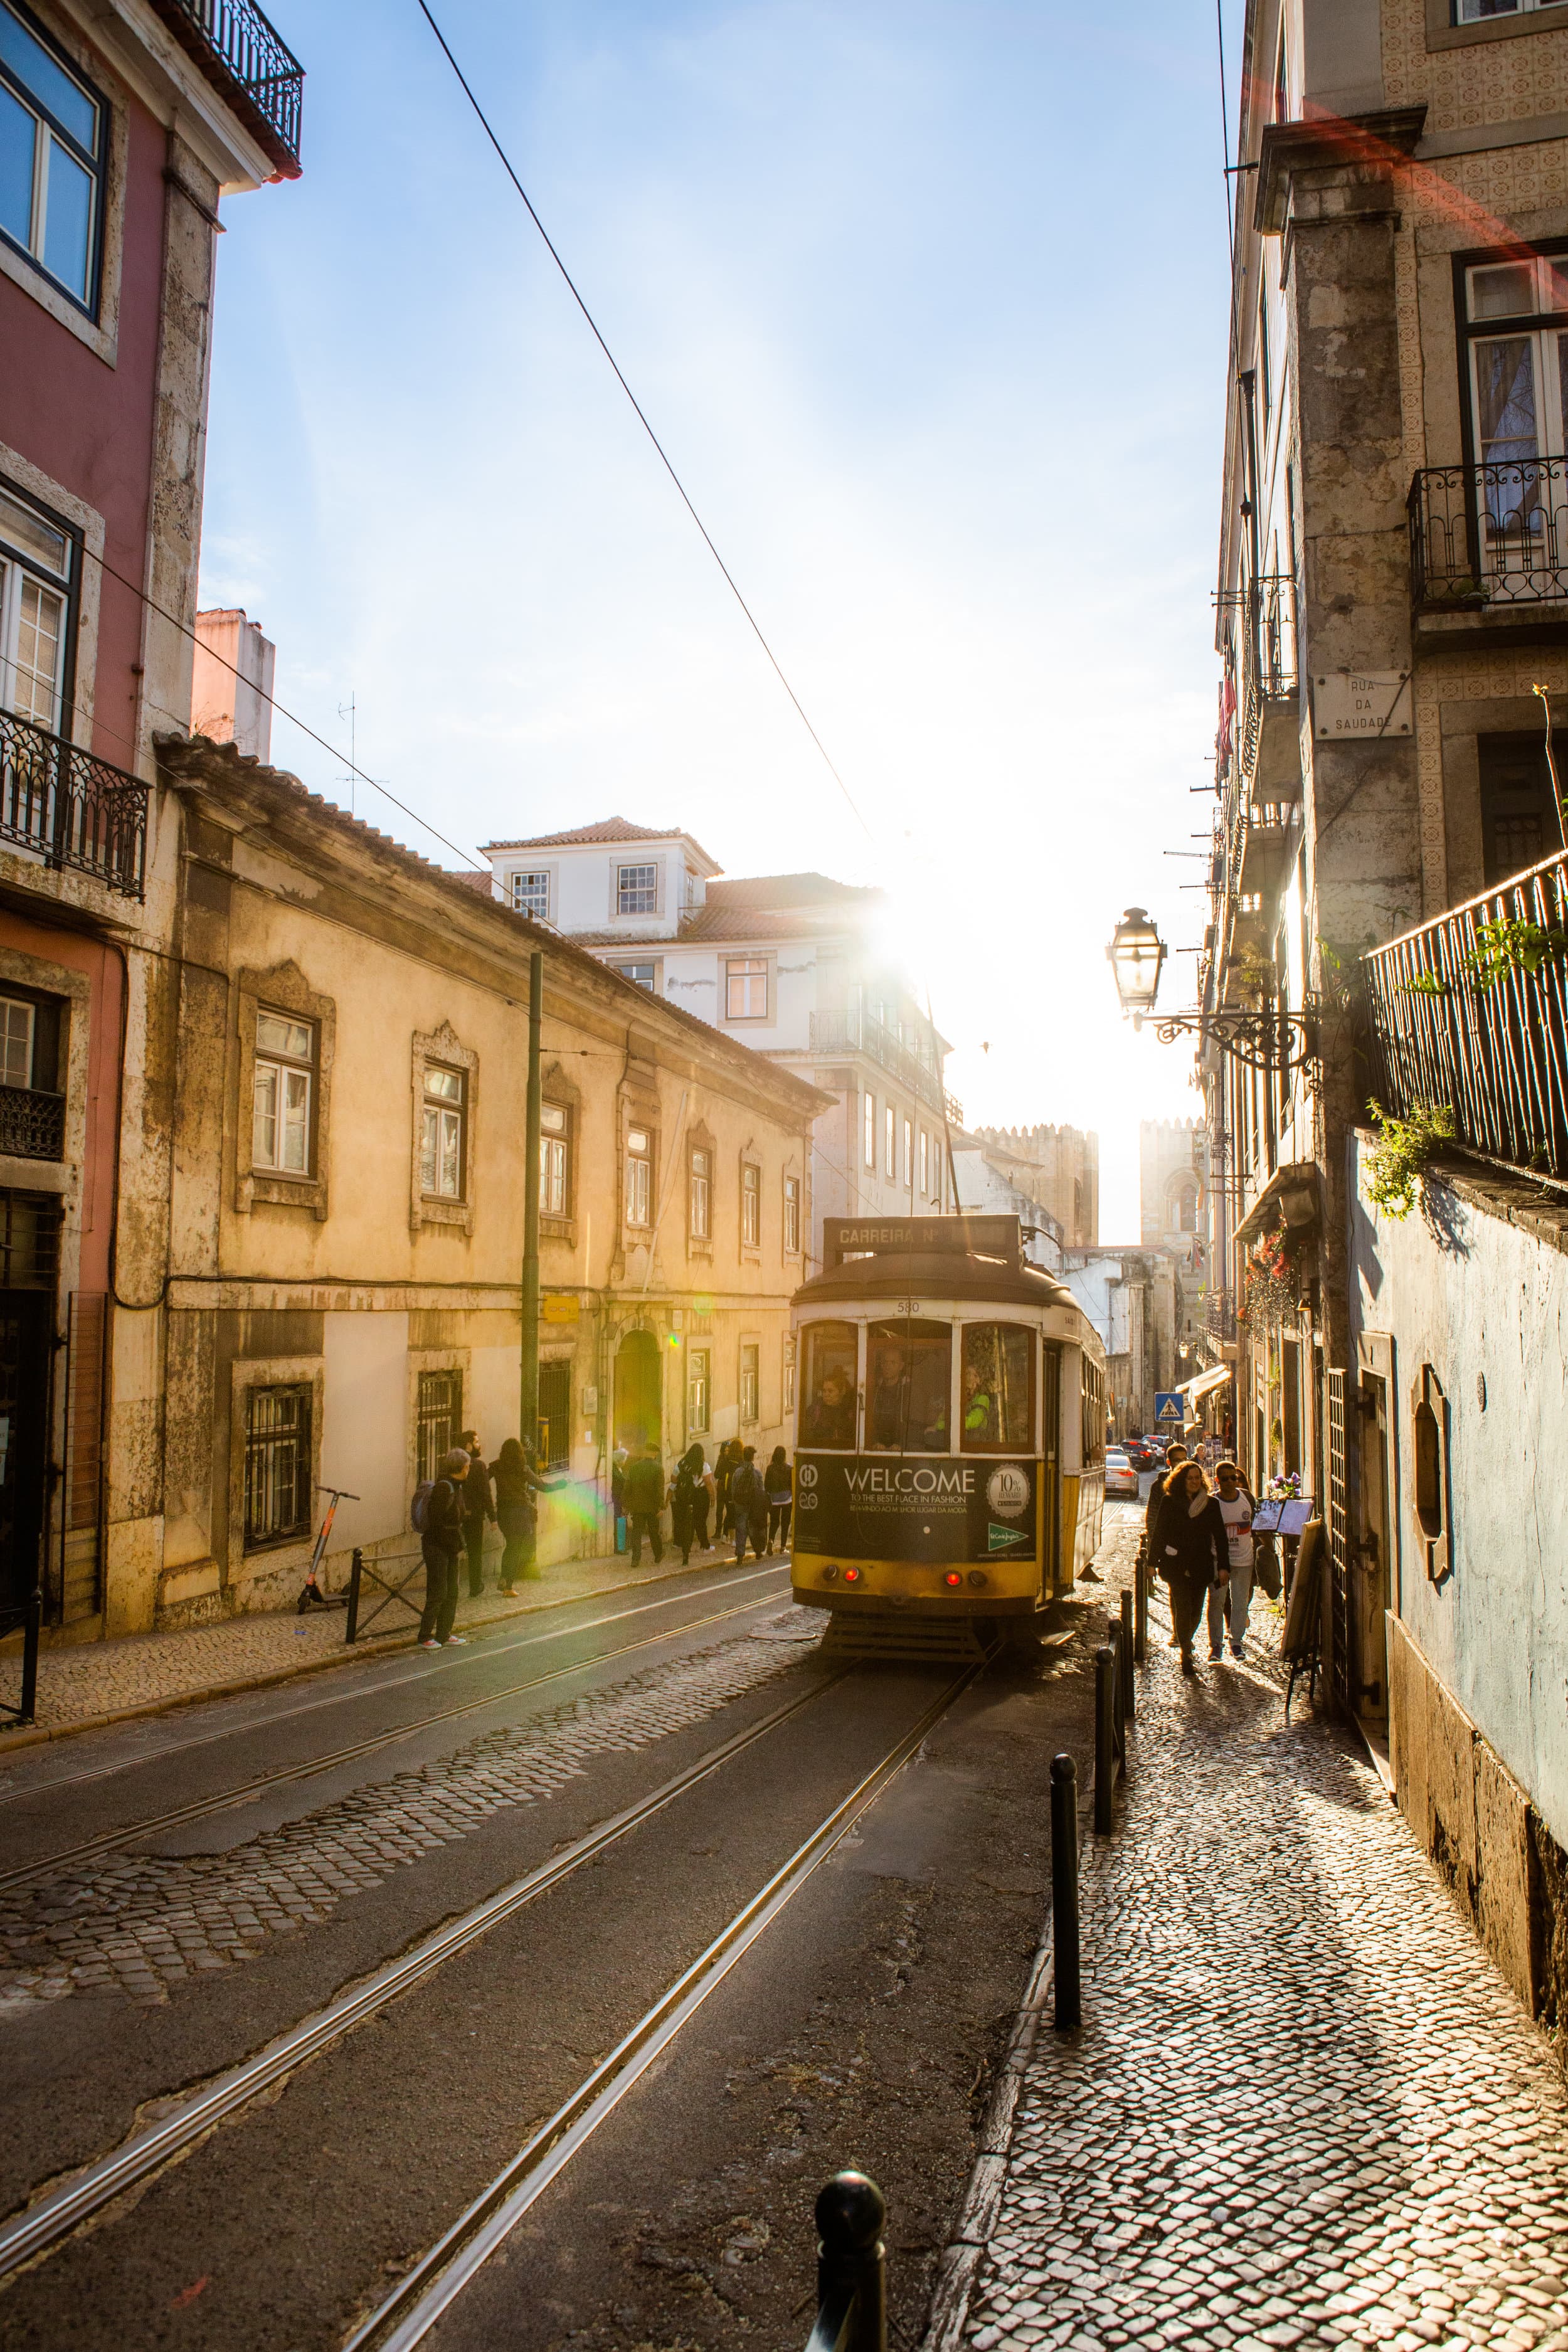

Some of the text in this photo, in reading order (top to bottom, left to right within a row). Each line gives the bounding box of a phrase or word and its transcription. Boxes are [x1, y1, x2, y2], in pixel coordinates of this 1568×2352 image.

[1352, 681, 1375, 691] RUA
[1355, 699, 1372, 710] DA
[1336, 717, 1392, 729] SAUDADE
[839, 1229, 914, 1244] CARREIRA
[898, 1302, 919, 1313] 580
[844, 1468, 975, 1493] WELCOME
[862, 1494, 875, 1502] THE
[877, 1495, 894, 1503] BEST
[896, 1495, 918, 1503] PLACE
[931, 1495, 966, 1504] FASHION
